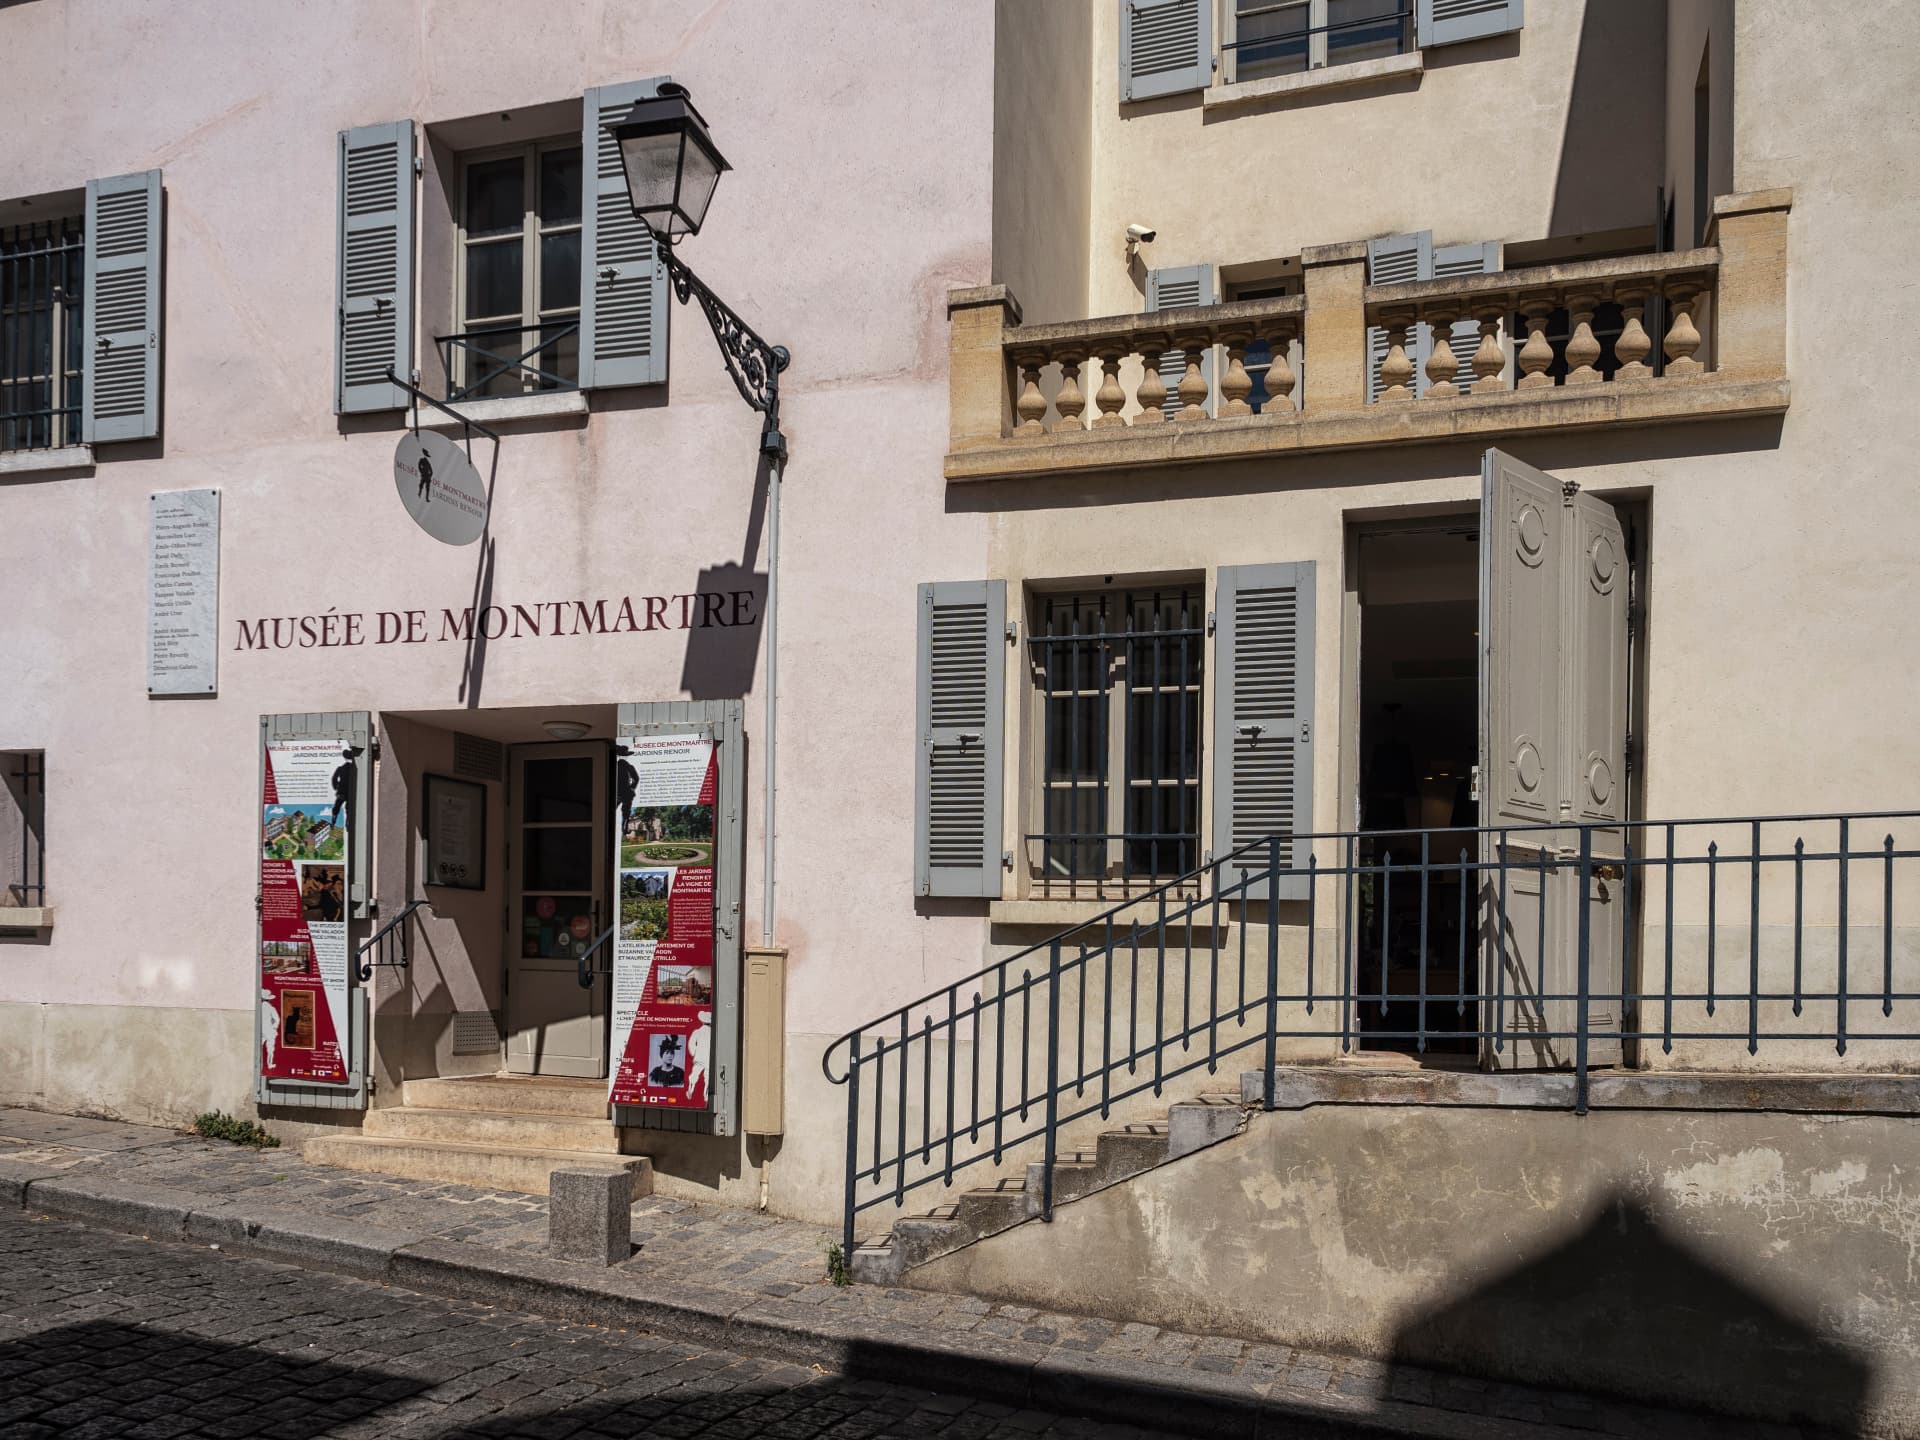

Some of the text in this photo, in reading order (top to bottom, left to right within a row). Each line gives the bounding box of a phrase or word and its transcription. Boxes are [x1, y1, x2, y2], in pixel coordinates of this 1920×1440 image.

[396, 461, 418, 477] MUSÉE
[432, 478, 486, 509] DE MONTMARTRE
[459, 502, 483, 518] RENOIR
[234, 590, 758, 651] MUSÉE DE MONTMARTRE
[667, 738, 713, 747] MONTMARTRE
